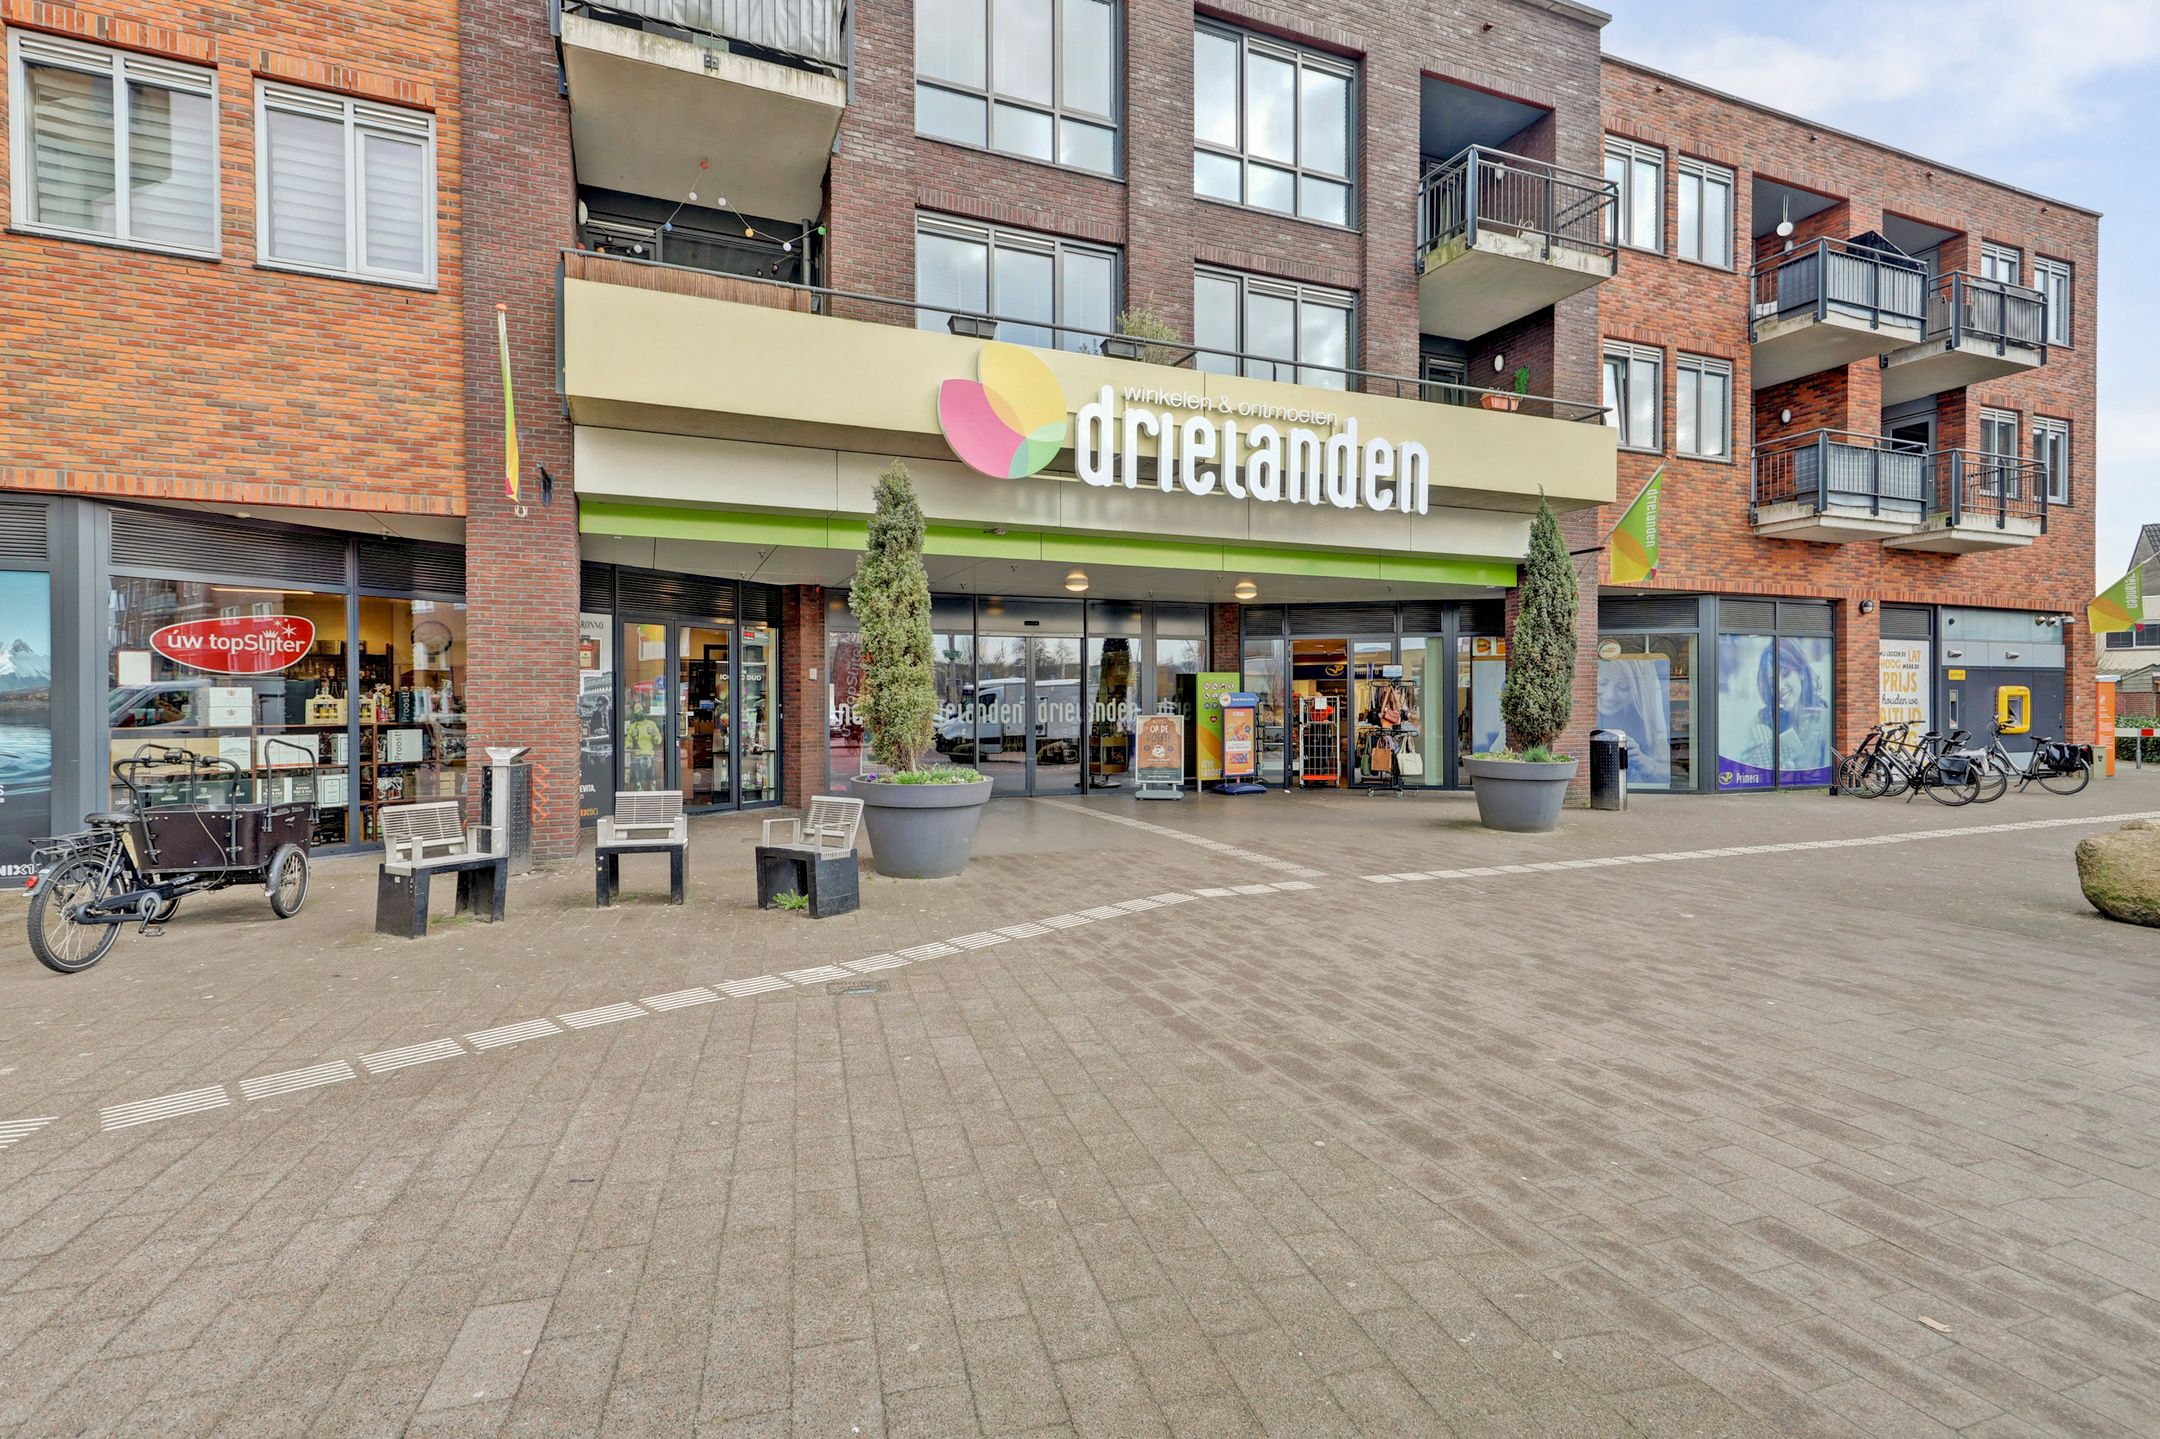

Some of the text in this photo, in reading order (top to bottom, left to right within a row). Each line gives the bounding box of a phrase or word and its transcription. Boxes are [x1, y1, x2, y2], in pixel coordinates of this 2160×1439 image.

[1124, 386, 1338, 426] winkelen & ontmoeten
[1075, 384, 1430, 516] drielanden
[1646, 488, 1660, 548] drielanden
[167, 630, 306, 656] úw topSlijter
[1880, 659, 1900, 669] HOOG
[1907, 649, 1921, 662] LAT
[747, 673, 762, 682] DUO
[1882, 671, 1918, 693] PRIJS
[402, 691, 410, 722] Proost!
[1881, 694, 1919, 705] houden we
[1150, 724, 1169, 733] OP DE
[394, 730, 402, 761] Proost!
[1736, 772, 1760, 784] Primera
[0, 864, 36, 877] NIX1
